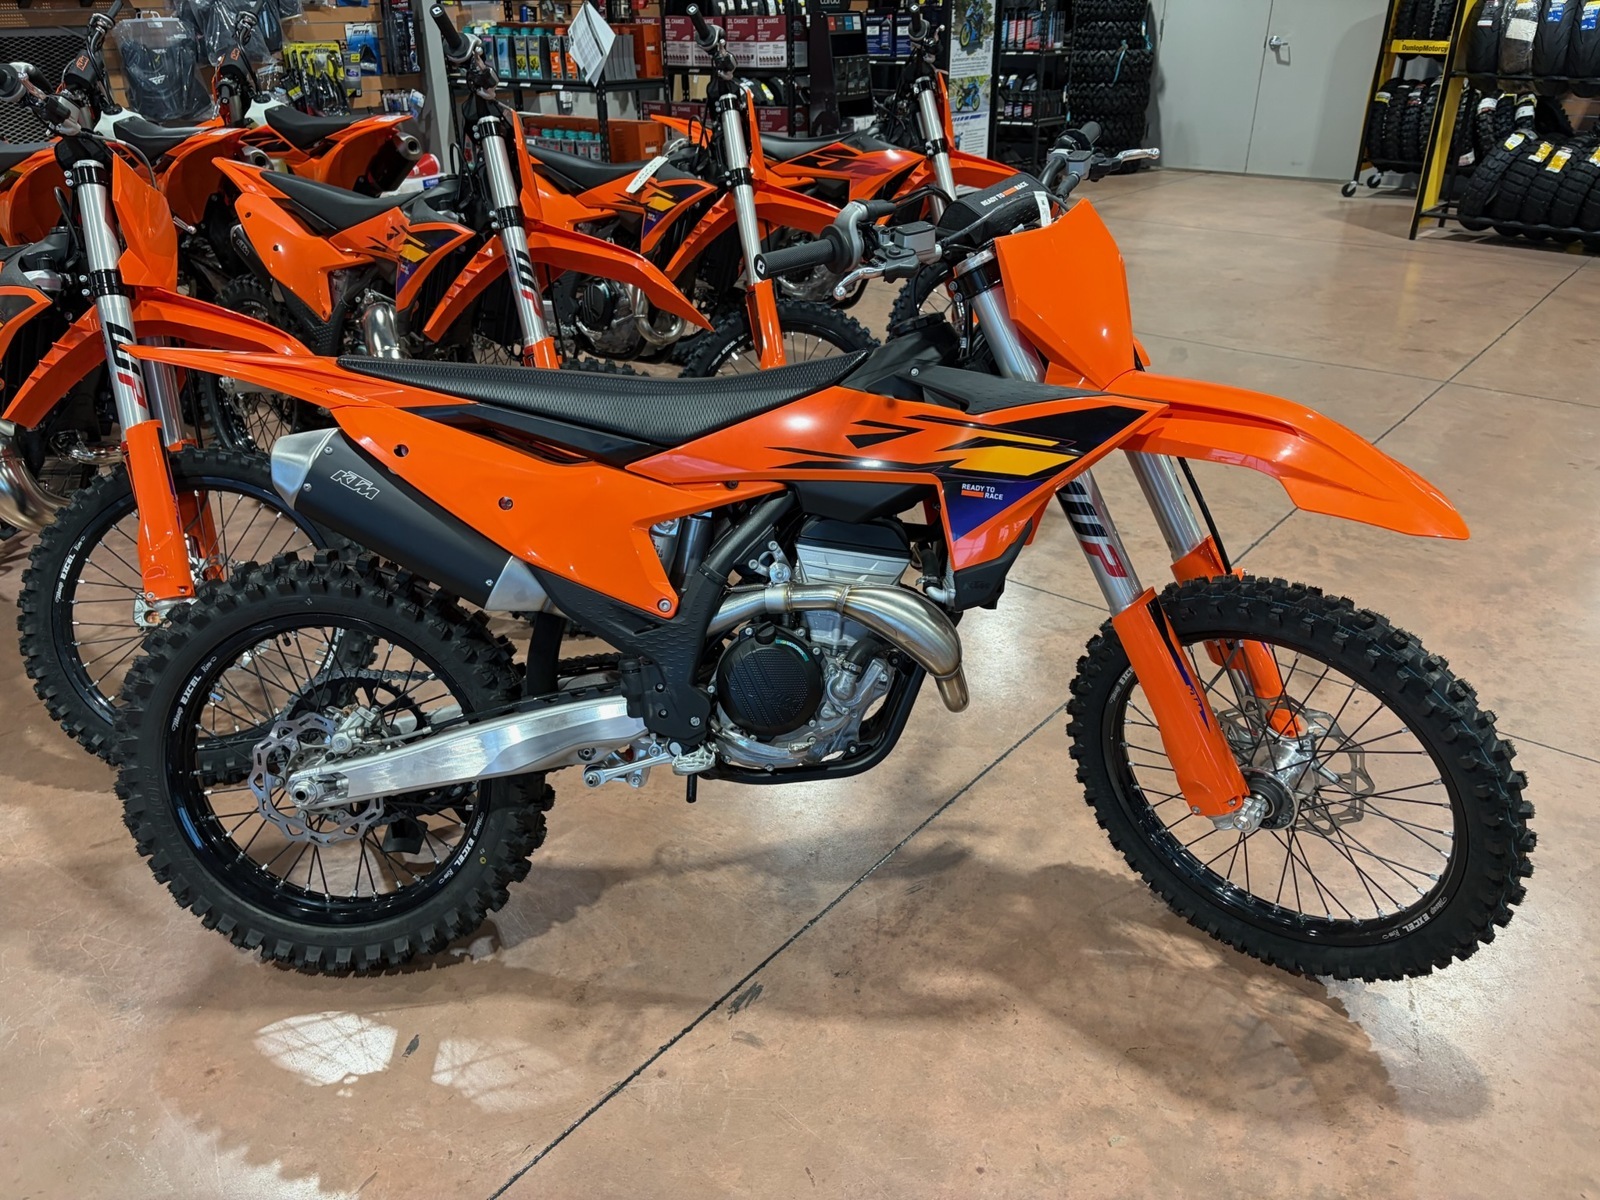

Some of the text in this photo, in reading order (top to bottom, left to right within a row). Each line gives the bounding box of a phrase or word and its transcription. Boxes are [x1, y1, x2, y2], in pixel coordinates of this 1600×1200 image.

[980, 195, 999, 206] READY
[1013, 181, 1029, 190] RACE
[330, 469, 380, 500] KTM
[961, 483, 996, 493] READY TO
[984, 492, 1003, 501] RACE
[60, 553, 76, 580] EXCEL
[1118, 665, 1135, 685] EXCE
[180, 675, 202, 705] EXCEL
[453, 837, 475, 867] EXCEL
[1401, 912, 1431, 933] EXCEL
